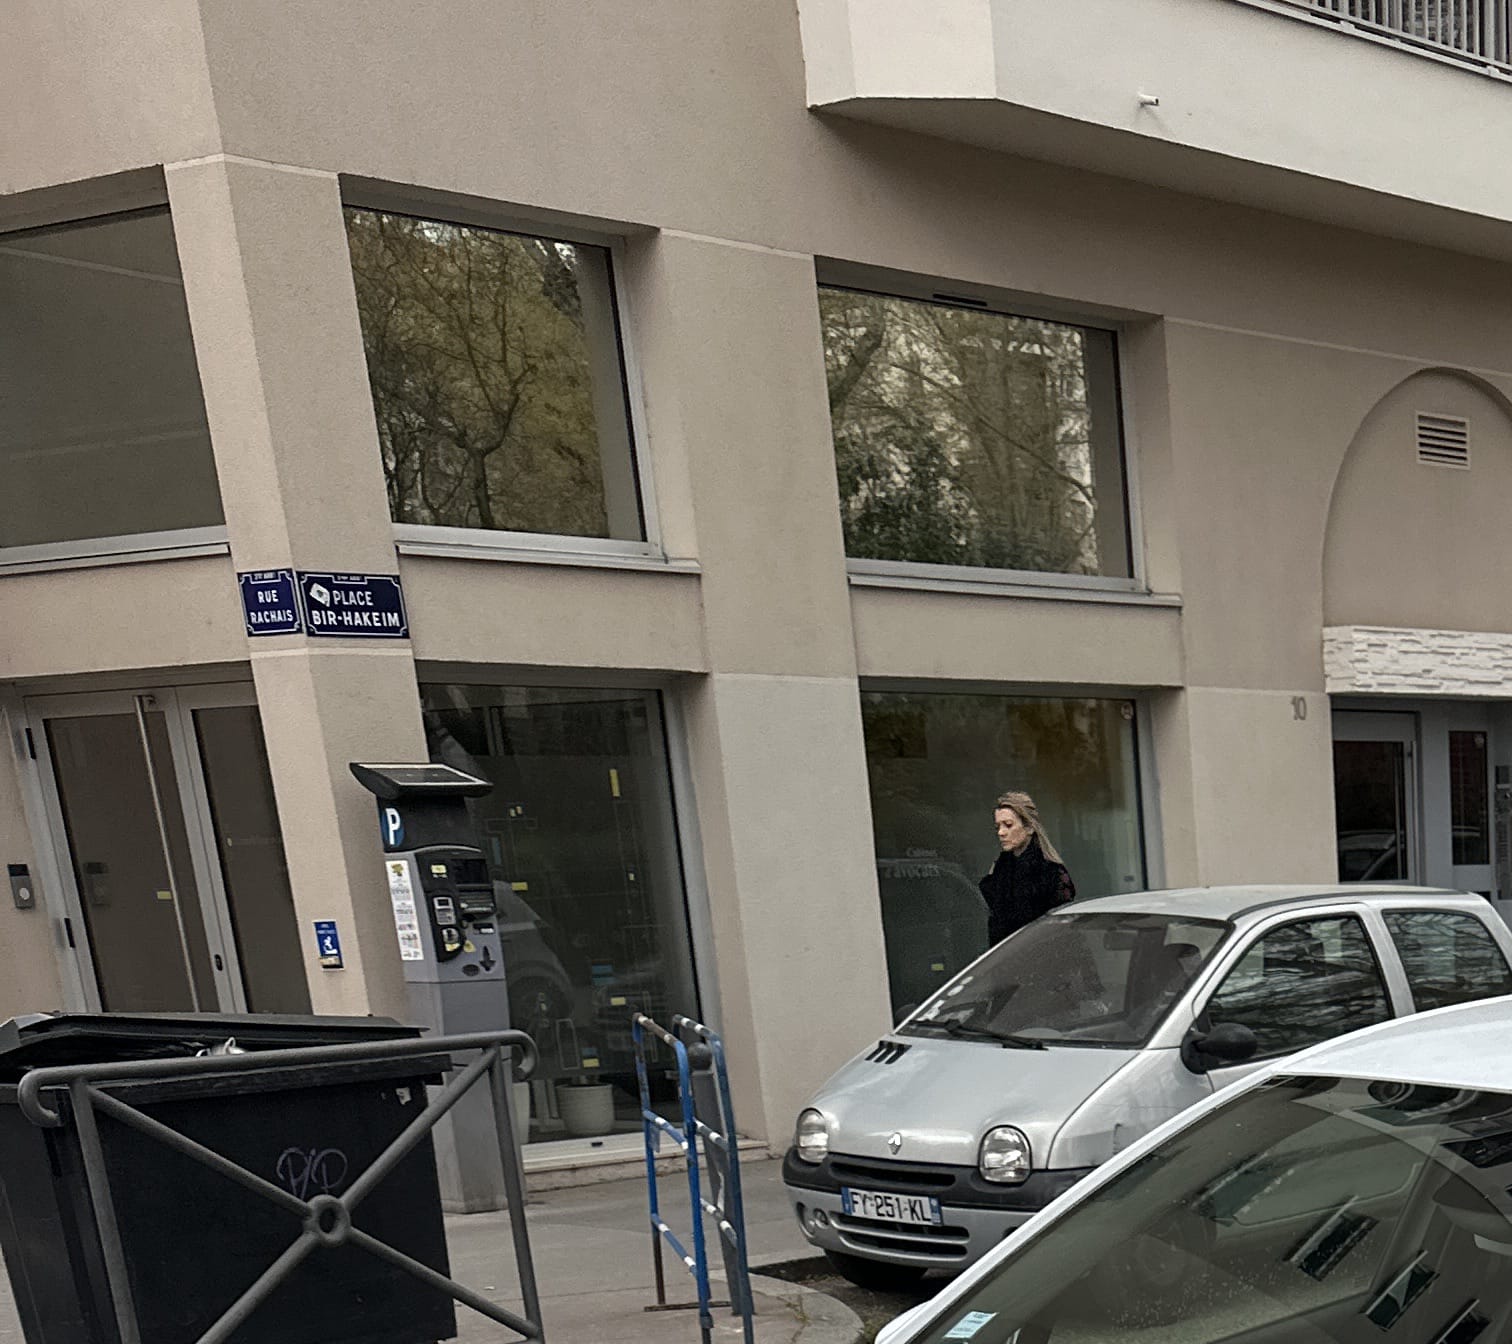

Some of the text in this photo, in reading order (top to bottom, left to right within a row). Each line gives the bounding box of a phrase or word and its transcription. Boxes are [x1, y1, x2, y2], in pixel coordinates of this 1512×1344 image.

[257, 590, 279, 604] RUE
[332, 590, 374, 606] PLACE
[250, 610, 294, 624] RACHAIS
[311, 610, 400, 627] BIR-HAKEIM
[1290, 696, 1307, 720] 10
[385, 808, 401, 845] P
